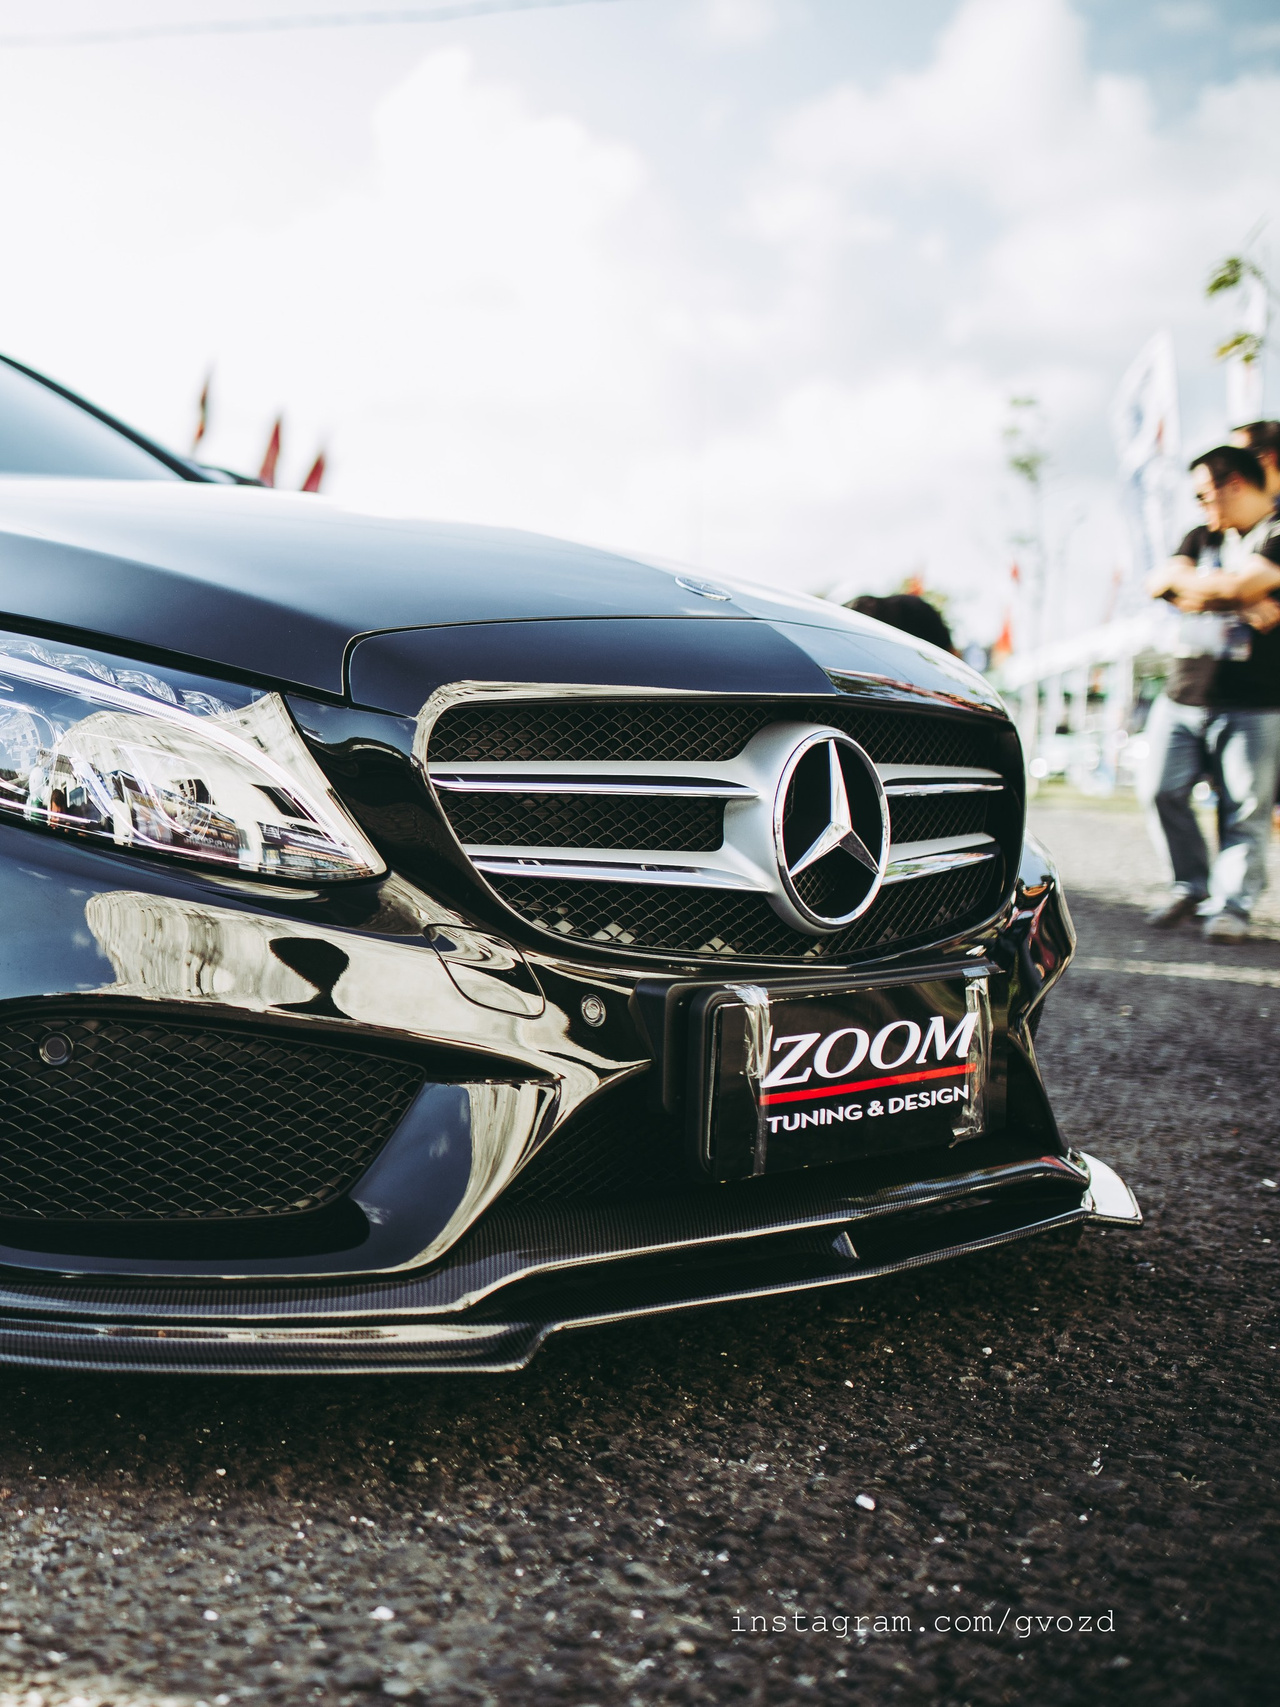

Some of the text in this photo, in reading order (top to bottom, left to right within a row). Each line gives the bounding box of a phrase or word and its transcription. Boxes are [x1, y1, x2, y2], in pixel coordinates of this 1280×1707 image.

[759, 1012, 980, 1088] ZOOM
[766, 1084, 970, 1133] TUNING & DESIGN
